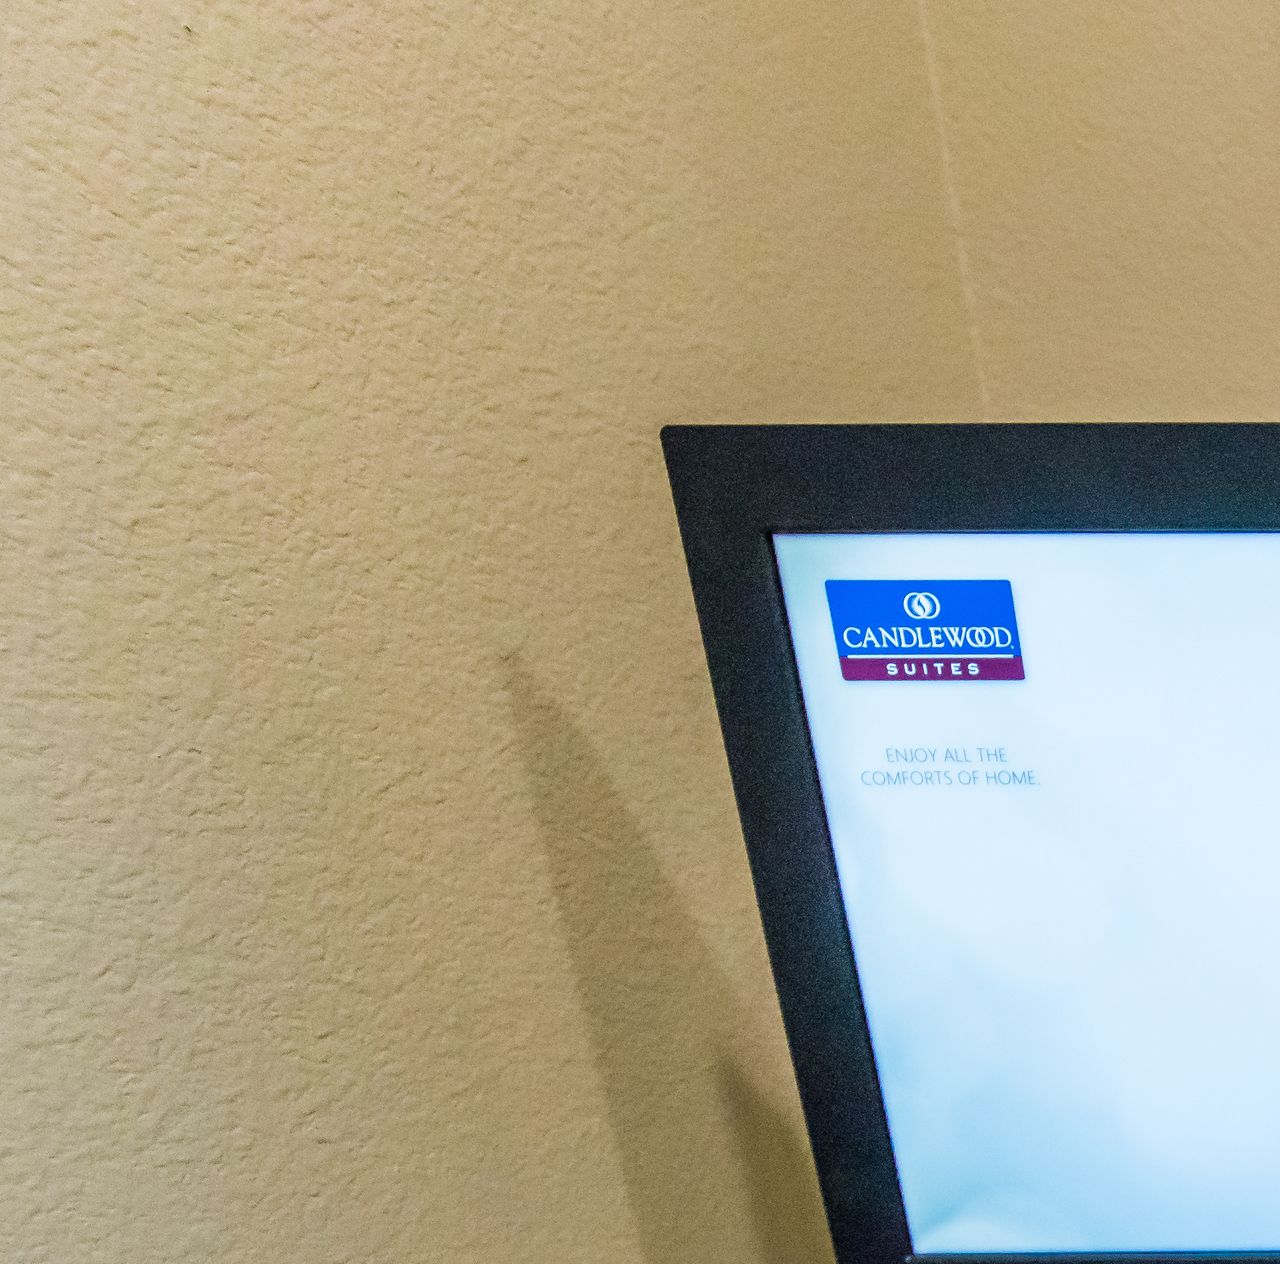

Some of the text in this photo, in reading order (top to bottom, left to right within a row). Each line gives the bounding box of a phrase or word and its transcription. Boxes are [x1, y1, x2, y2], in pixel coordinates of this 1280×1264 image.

[843, 627, 1012, 649] CANDLEWOOD
[886, 662, 980, 676] SUITES
[885, 748, 1008, 763] ENJOY ALL THE
[860, 770, 953, 786] COMFORTS
[957, 770, 980, 785] OF
